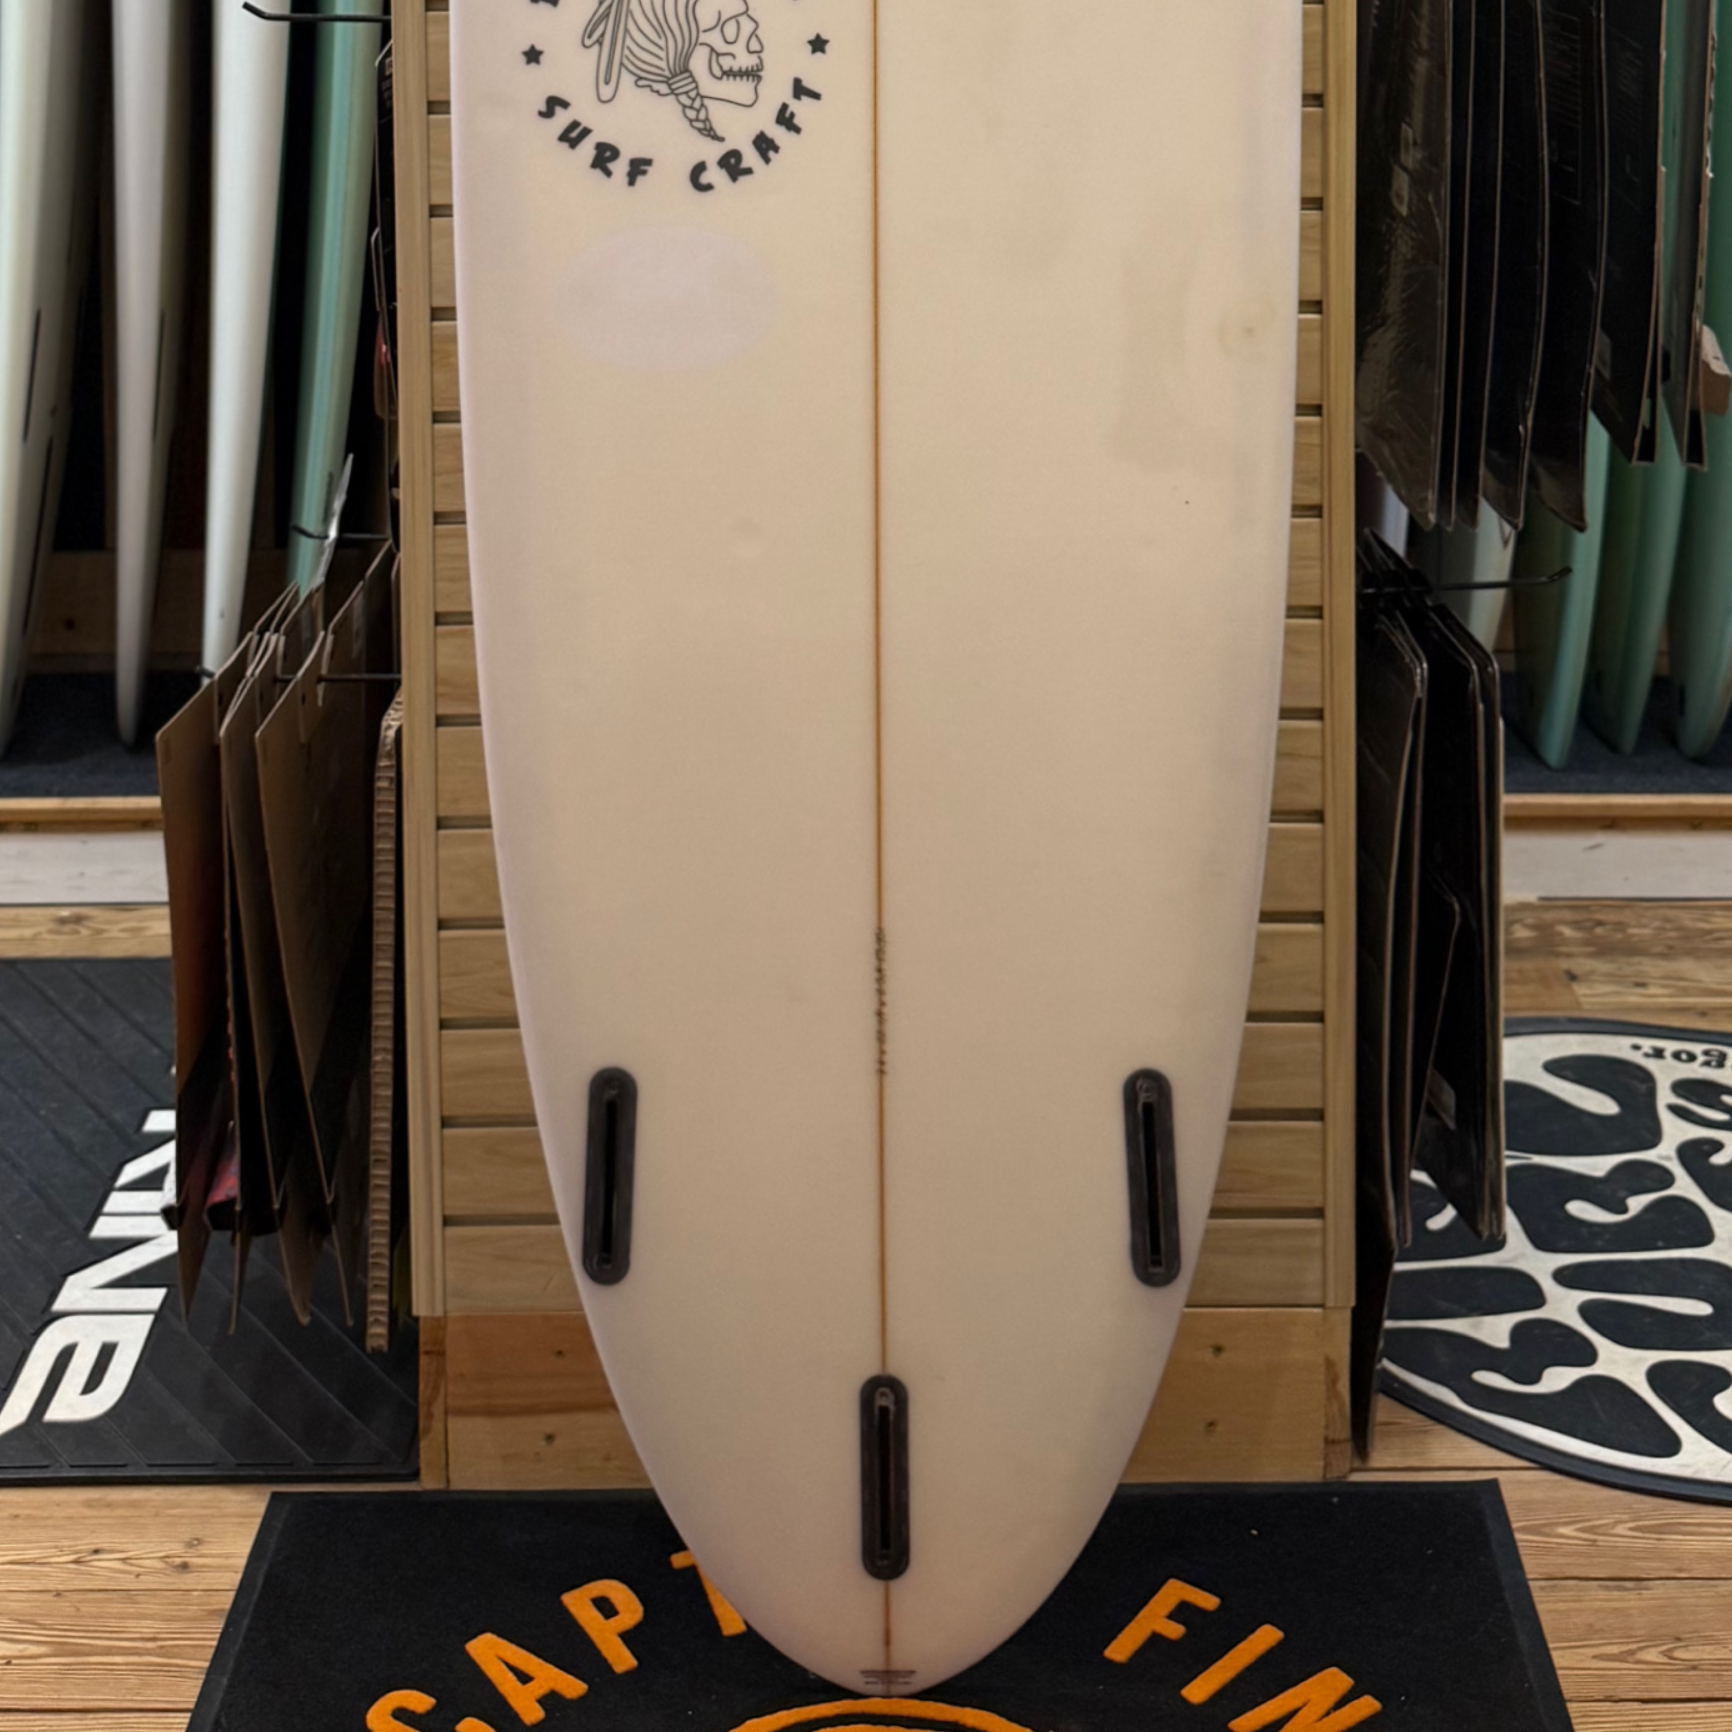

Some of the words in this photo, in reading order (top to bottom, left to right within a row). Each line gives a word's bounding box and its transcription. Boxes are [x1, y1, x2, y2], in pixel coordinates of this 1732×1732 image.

[537, 95, 654, 187] SURF
[689, 76, 822, 193] CRAFT
[1630, 1043, 1732, 1070] gor.
[365, 1549, 747, 1732] CAPT
